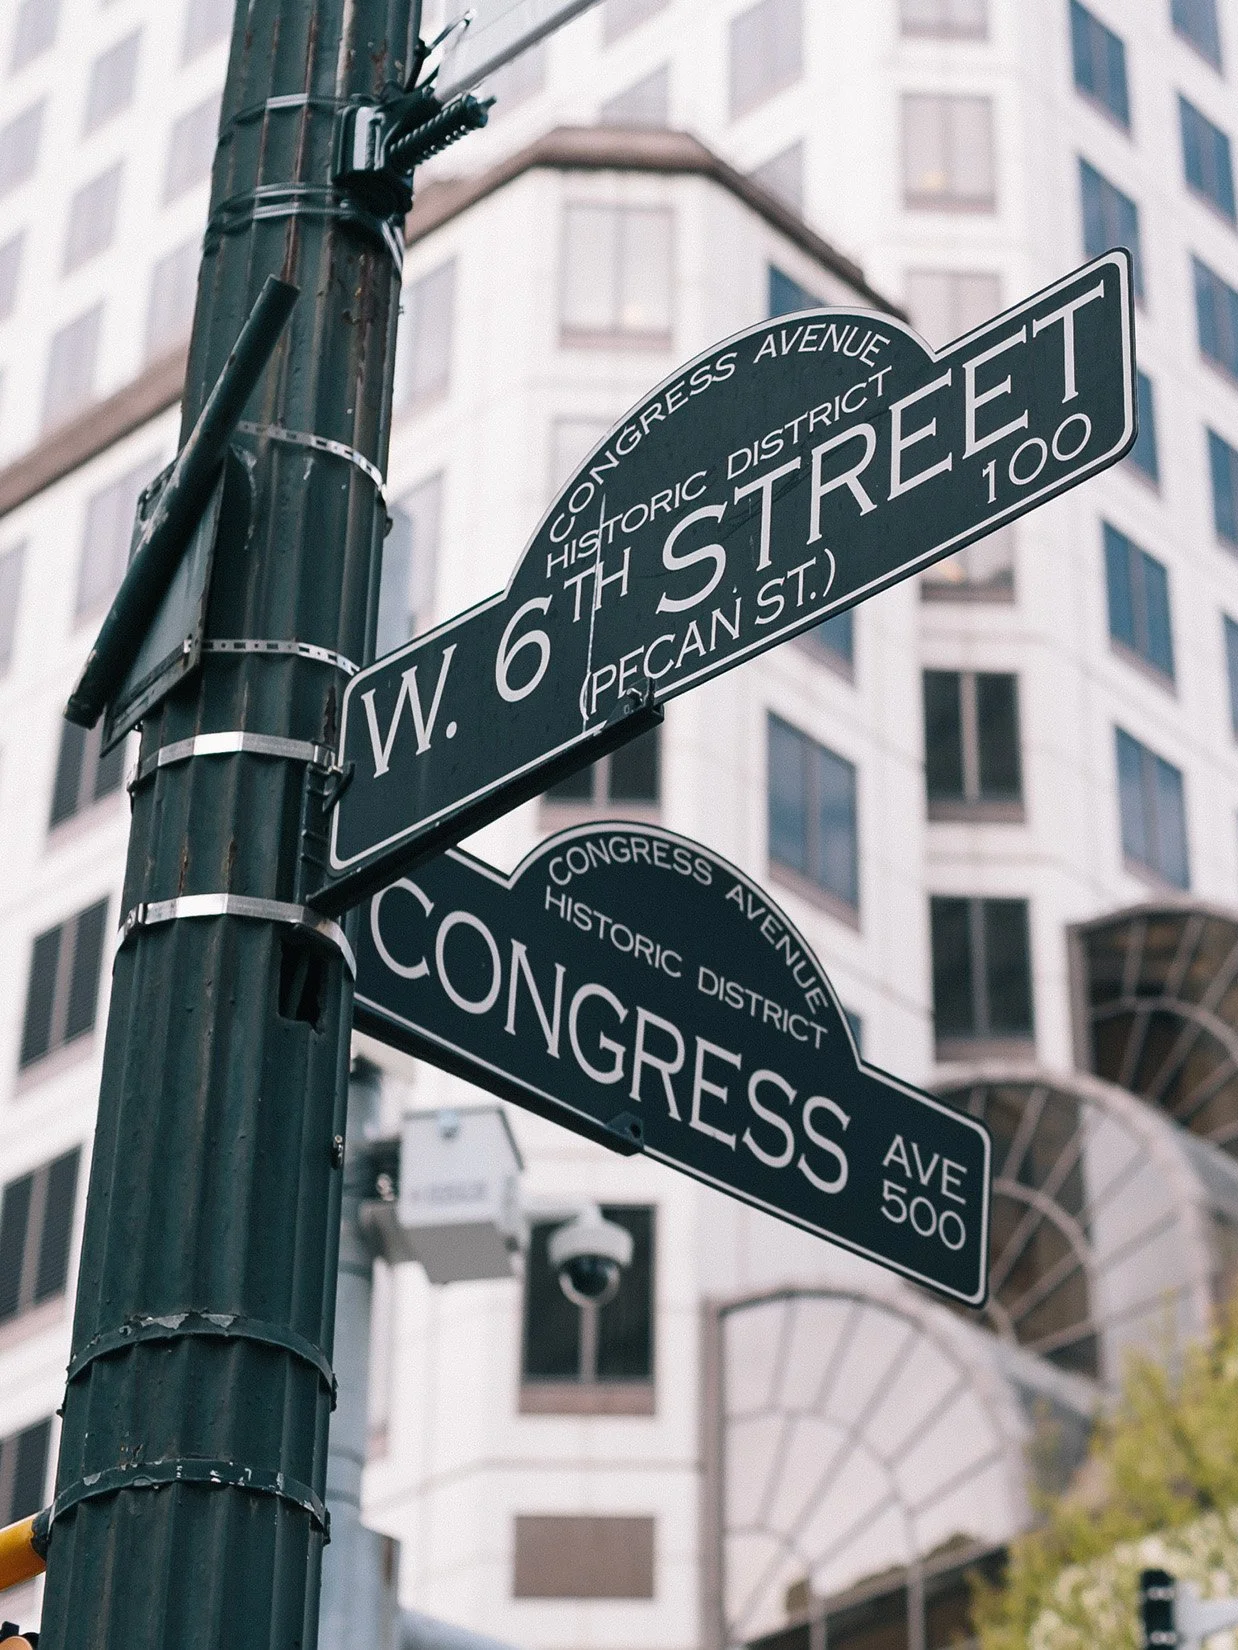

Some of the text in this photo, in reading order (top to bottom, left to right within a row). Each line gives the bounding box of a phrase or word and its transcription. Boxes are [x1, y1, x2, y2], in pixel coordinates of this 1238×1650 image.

[547, 366, 892, 578] HISTORIC DISTRICT
[550, 323, 891, 543] CONGRESS AVENUE
[983, 413, 1092, 504] 100
[361, 280, 1104, 778] W. 6TH STREET
[579, 548, 836, 721] (PECAN ST.)
[545, 886, 828, 1049] HISTORIC DISTRICT
[549, 836, 829, 1014] CONGRESS AVENUE
[370, 877, 851, 1194] CONGRESS
[881, 1179, 967, 1251] 500
[883, 1135, 967, 1205] AVE
